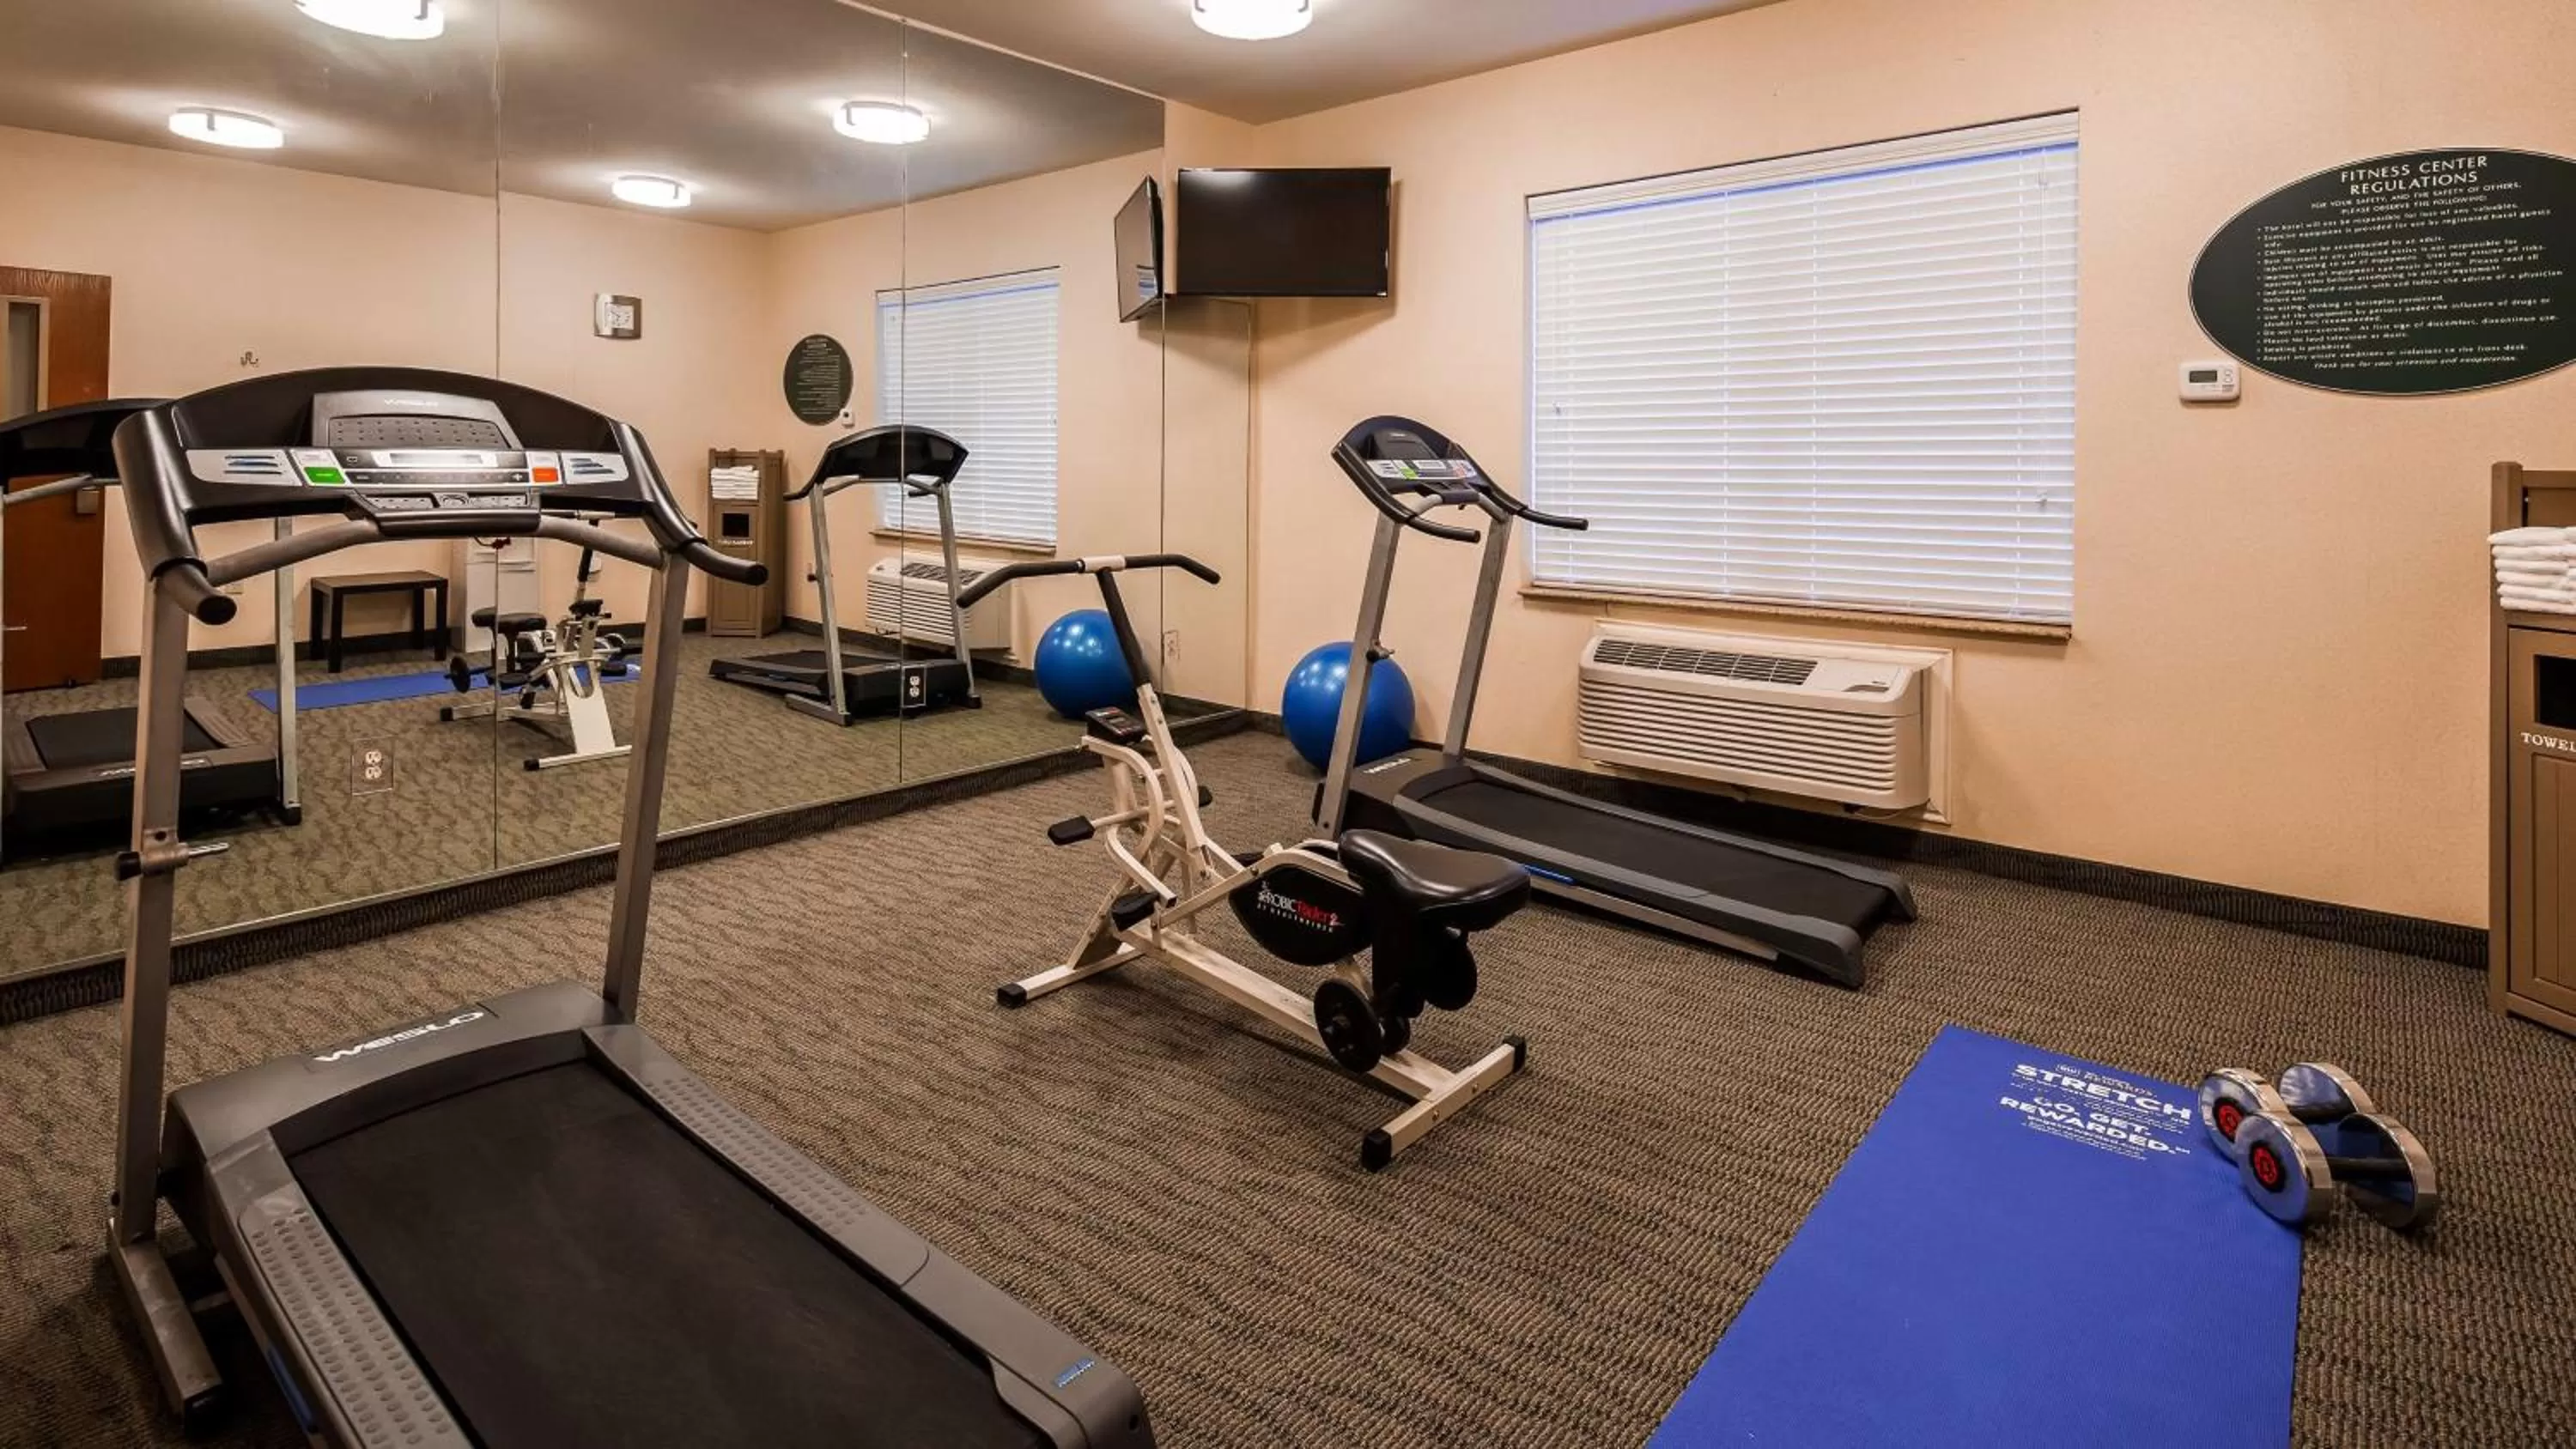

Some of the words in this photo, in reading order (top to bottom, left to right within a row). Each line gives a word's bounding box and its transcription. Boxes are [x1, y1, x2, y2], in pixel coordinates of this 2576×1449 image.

[2341, 164, 2409, 182] FITNESS
[2419, 155, 2487, 173] CENTER
[2350, 171, 2476, 195] REGULATIONS
[2341, 206, 2369, 215] PLEASE
[2372, 202, 2409, 211] OBSERVE
[313, 1012, 484, 1062] WESLO
[2014, 1064, 2191, 1121] STRETCH
[2090, 1113, 2151, 1136] GET.
